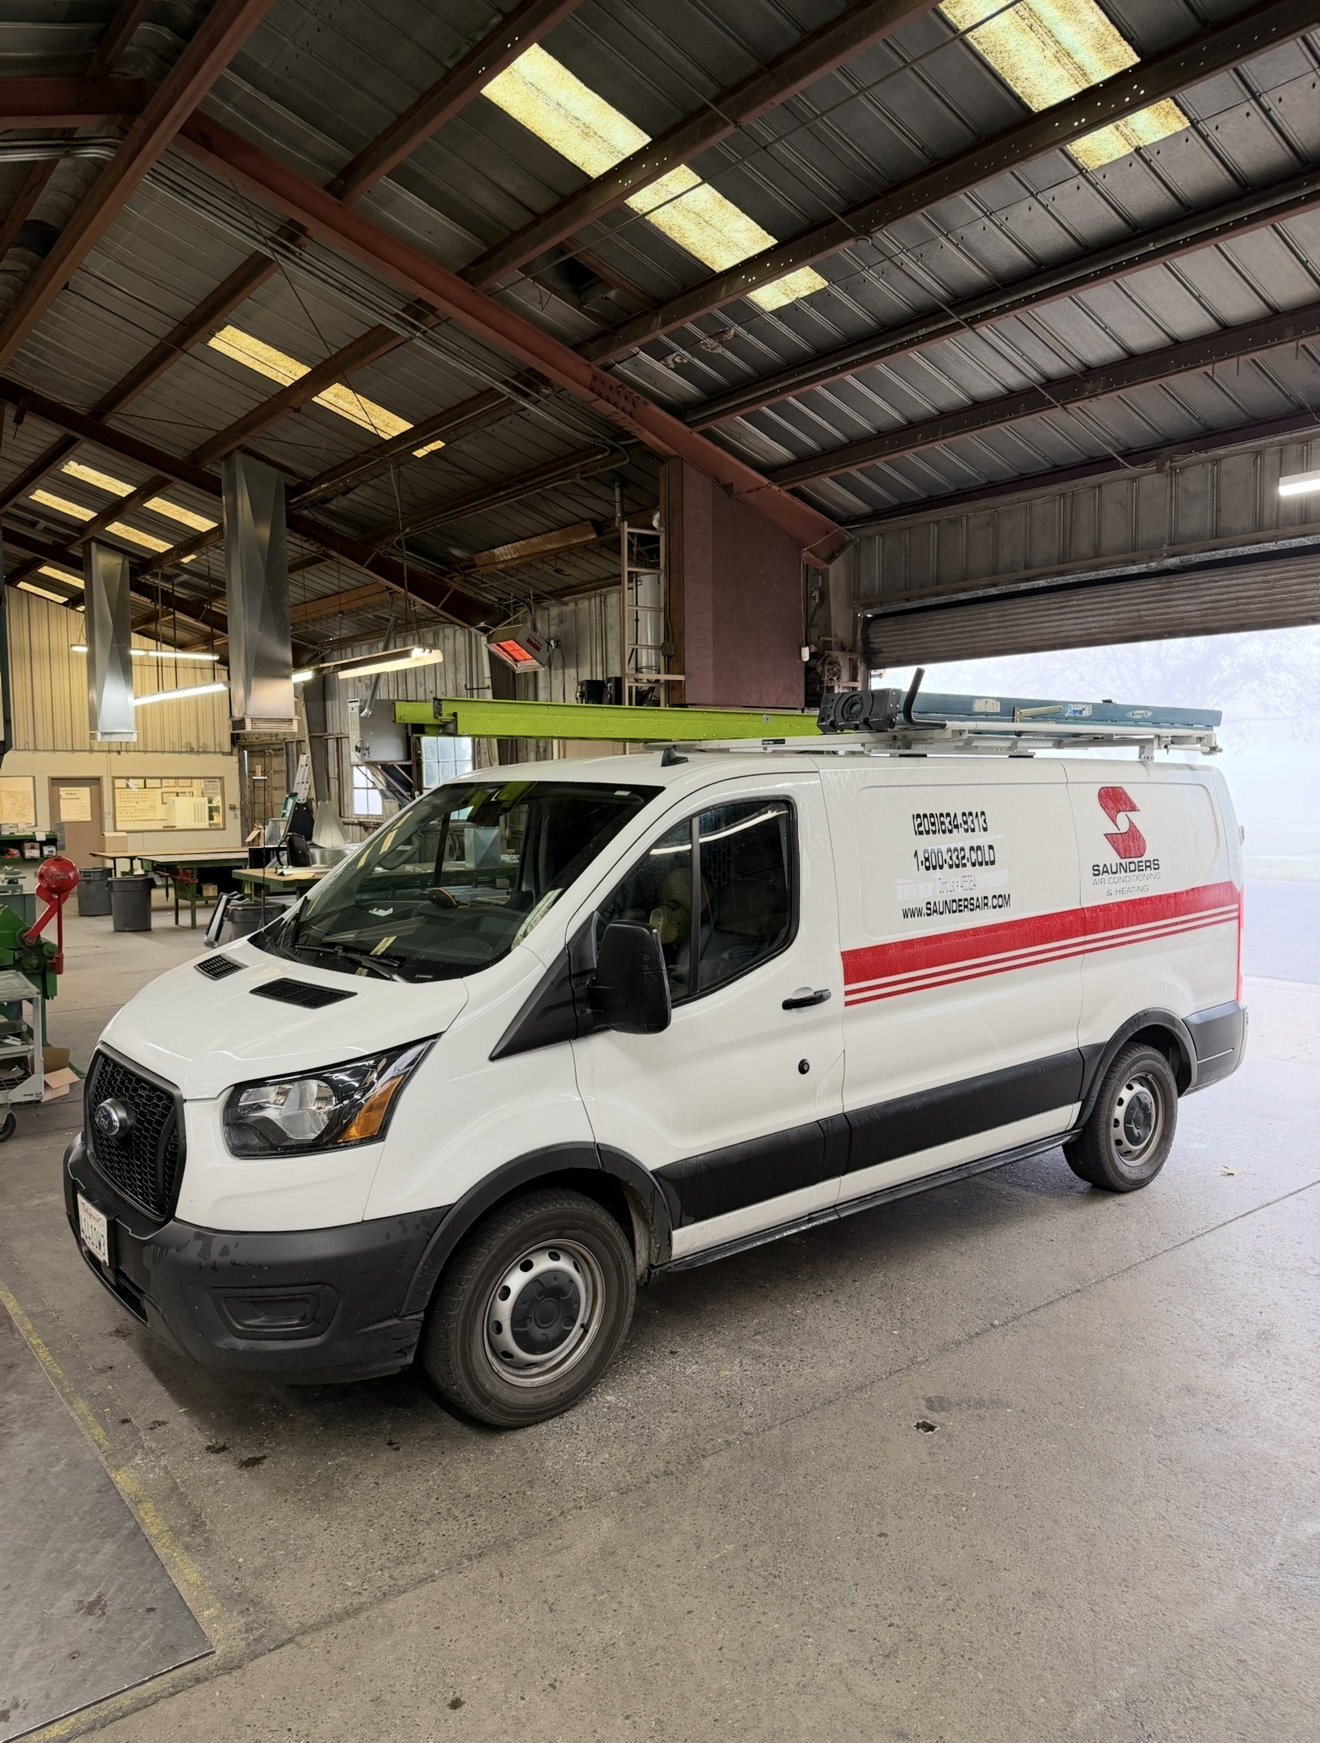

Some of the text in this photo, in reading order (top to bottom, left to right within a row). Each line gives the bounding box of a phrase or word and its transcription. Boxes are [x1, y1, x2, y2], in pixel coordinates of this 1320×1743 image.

[912, 811, 988, 836] (209)634-9313
[913, 844, 996, 872] 1-800-332-COLD
[1091, 859, 1160, 877] SAUNDERS
[1092, 872, 1161, 887] AIR CONDITIONING
[1106, 885, 1149, 897] & HEATING
